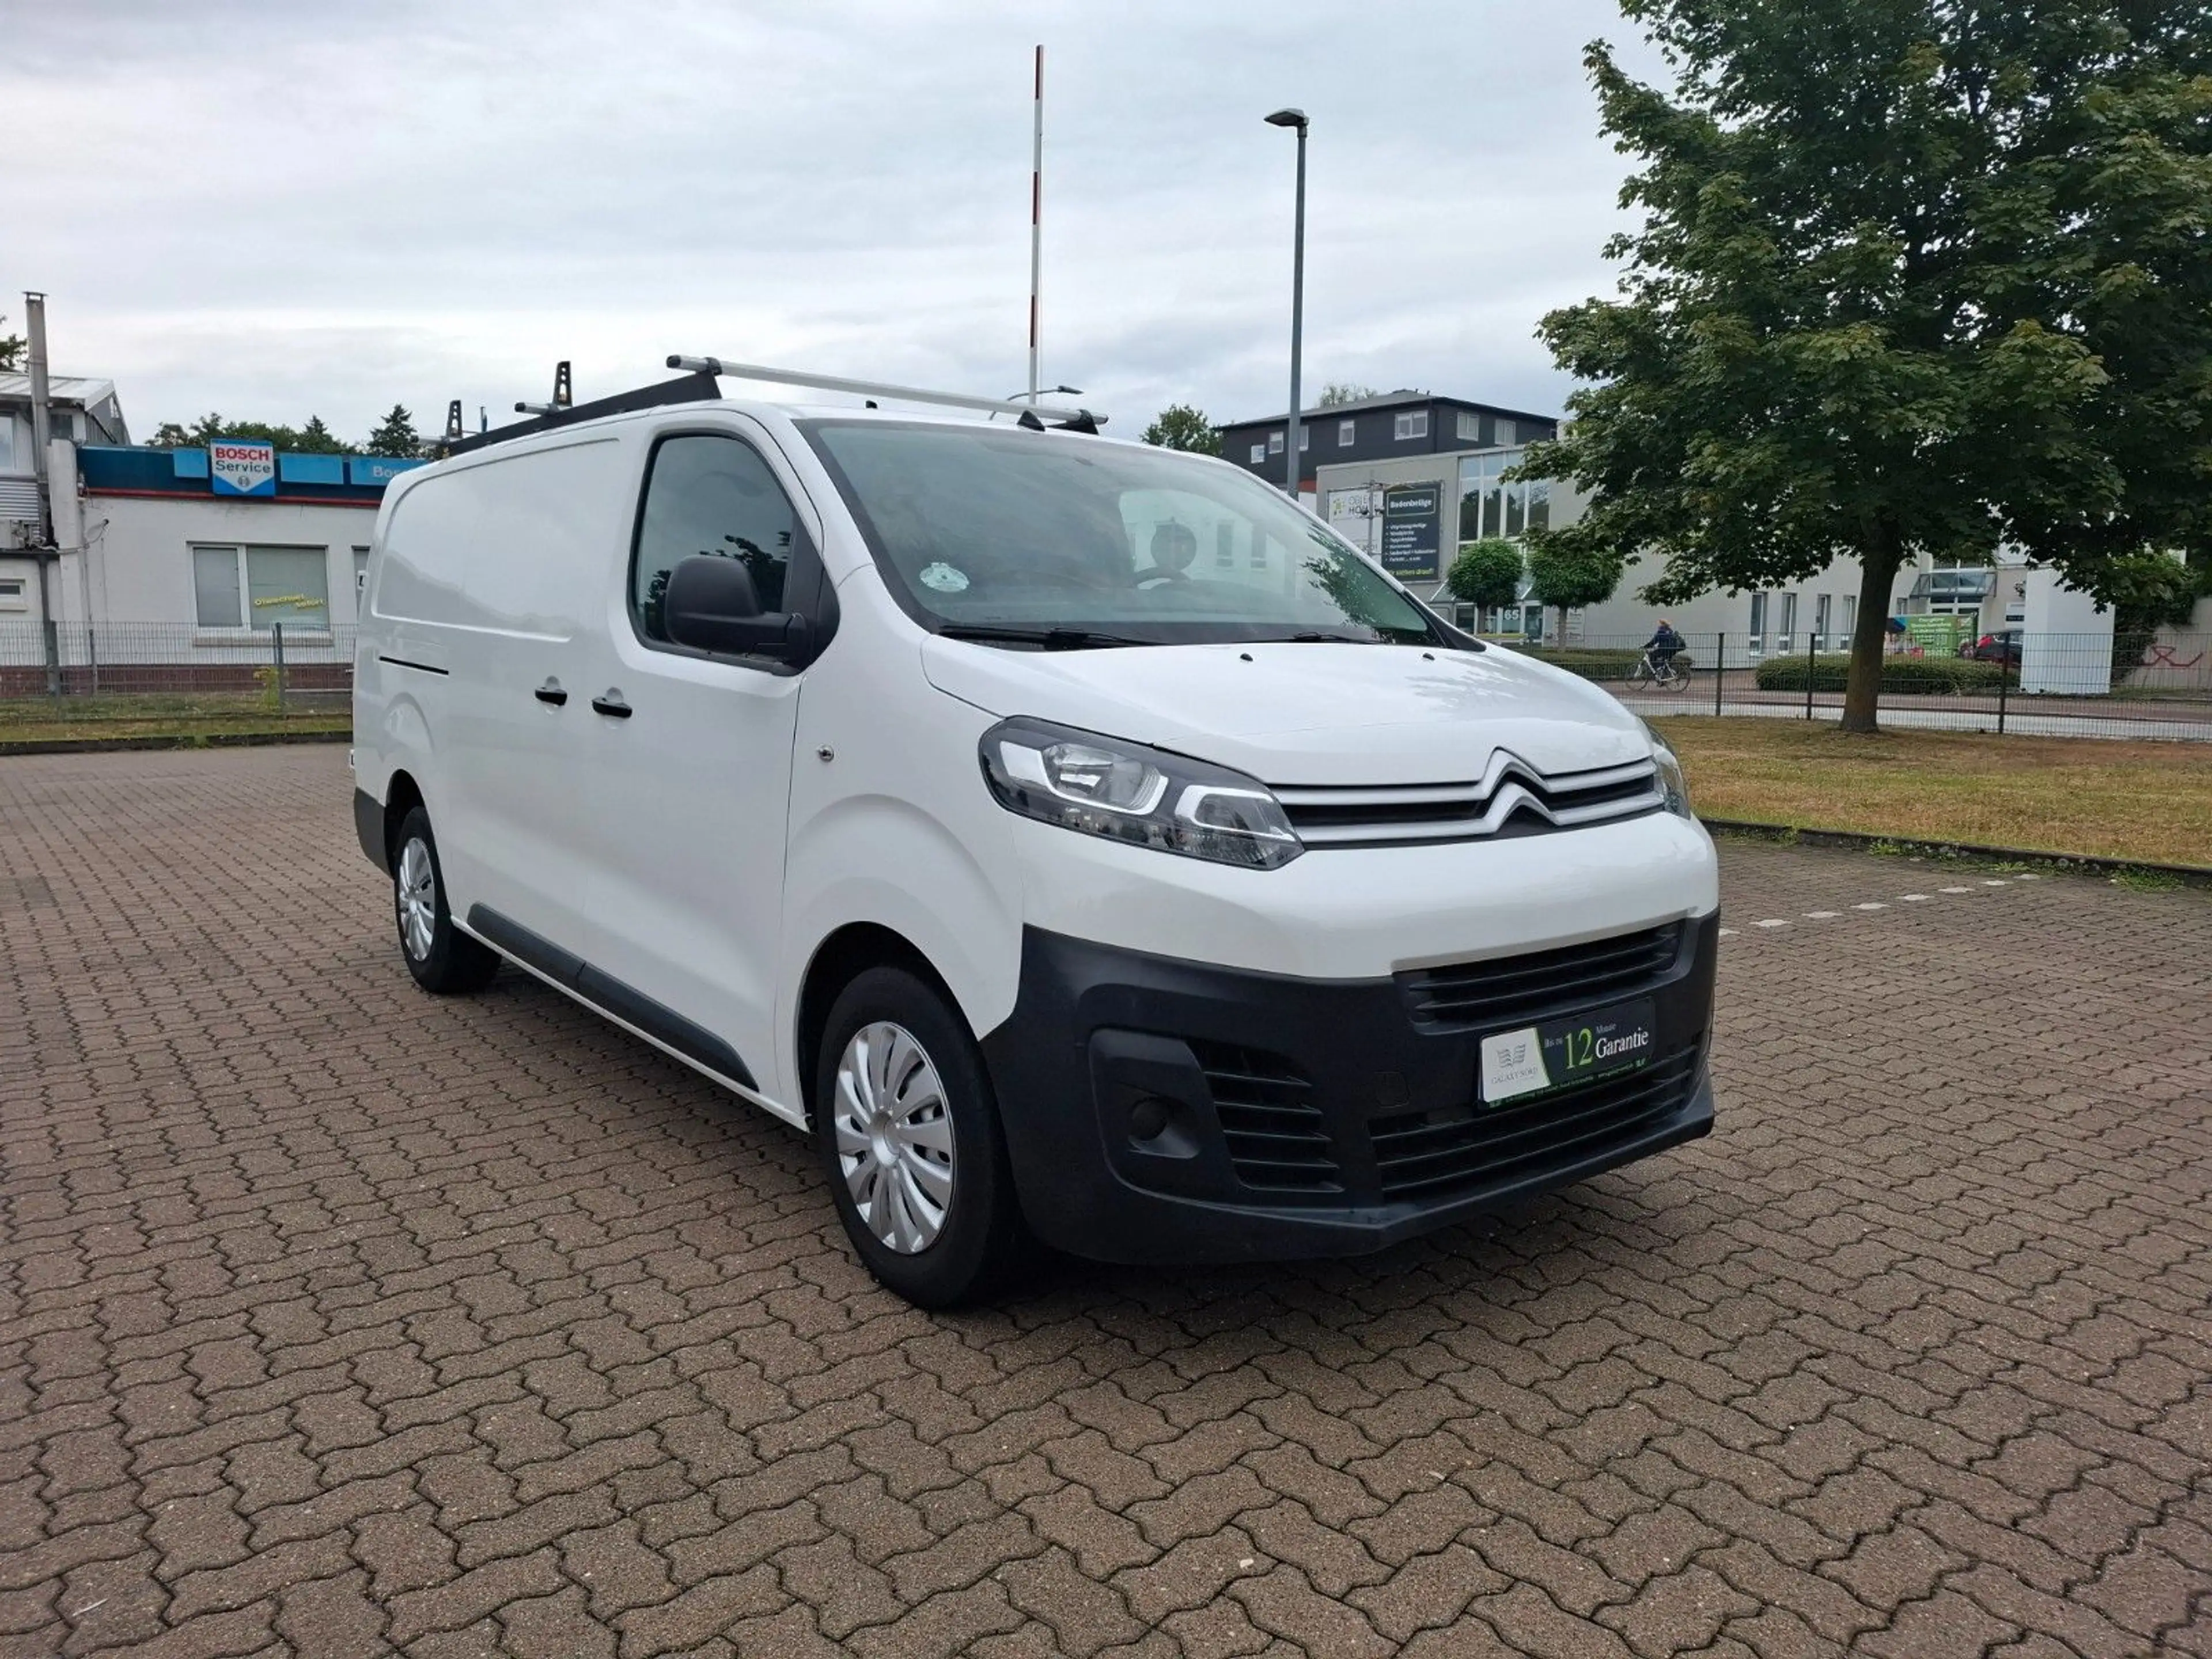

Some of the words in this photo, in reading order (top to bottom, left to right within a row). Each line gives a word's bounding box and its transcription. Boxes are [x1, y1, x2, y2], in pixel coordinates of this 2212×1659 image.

[215, 447, 269, 461] BOSCH
[215, 460, 271, 473] Service
[1504, 609, 1519, 620] 65
[1565, 1028, 1593, 1070] 12
[1595, 1027, 1649, 1059] Garantie
